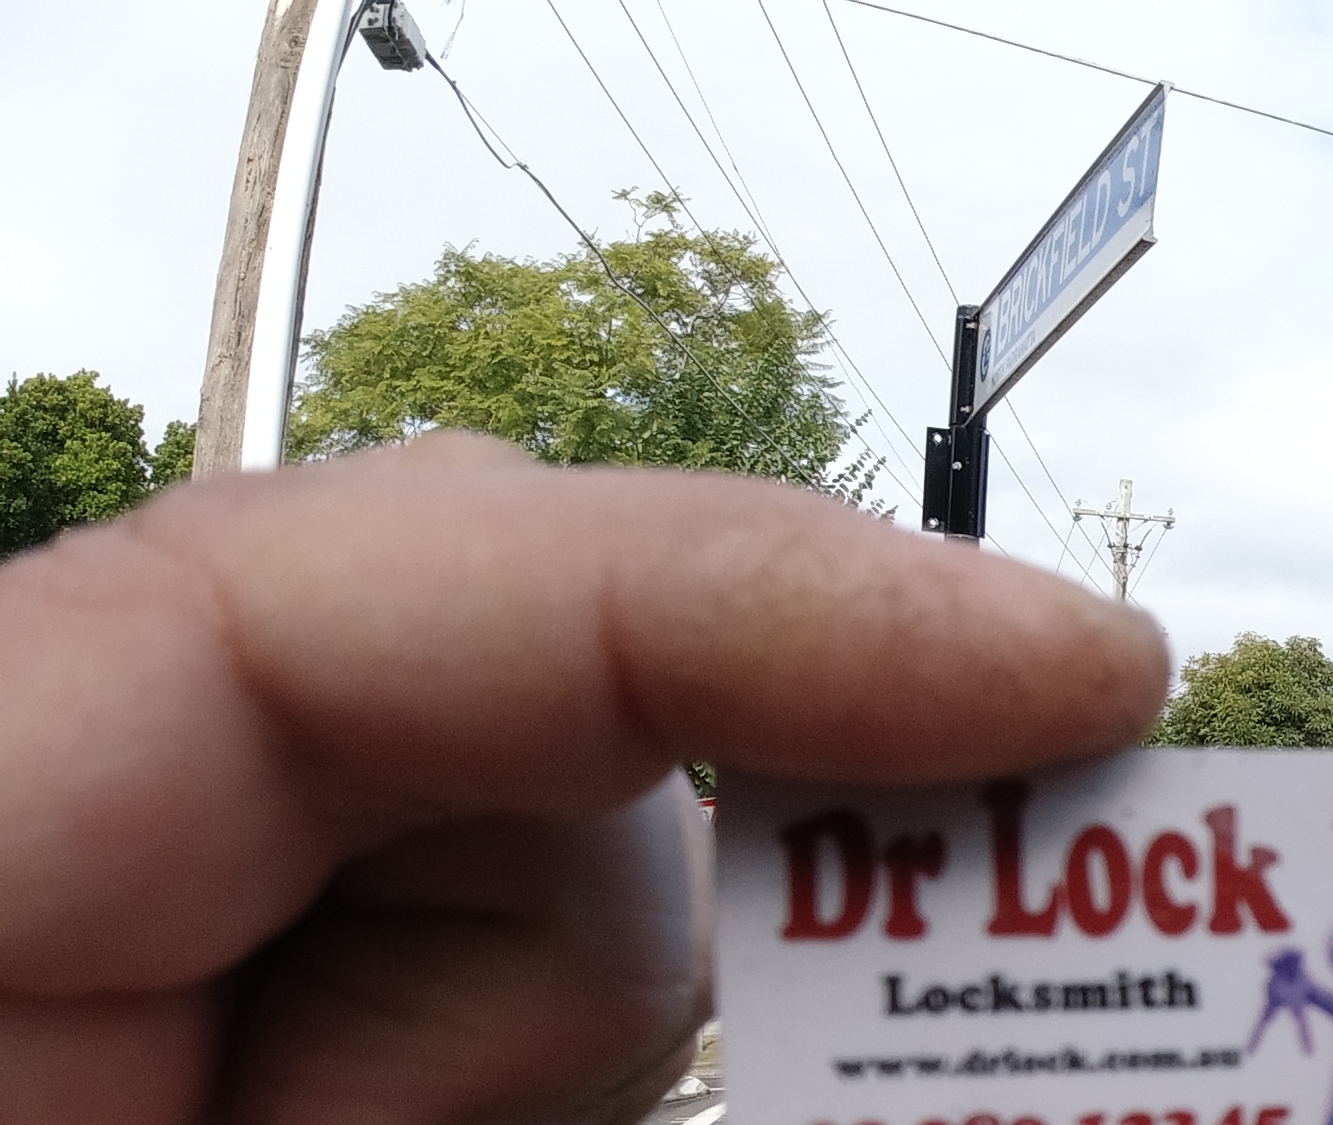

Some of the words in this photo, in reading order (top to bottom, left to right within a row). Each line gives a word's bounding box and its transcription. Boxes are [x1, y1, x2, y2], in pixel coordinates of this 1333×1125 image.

[997, 168, 1113, 357] BRICKFIELD
[1118, 110, 1160, 218] ST
[780, 808, 947, 941] Dr
[982, 779, 1291, 941] Lock
[881, 969, 1200, 1017] Locksmith
[832, 1046, 1242, 1080] www.drlock.com.au
